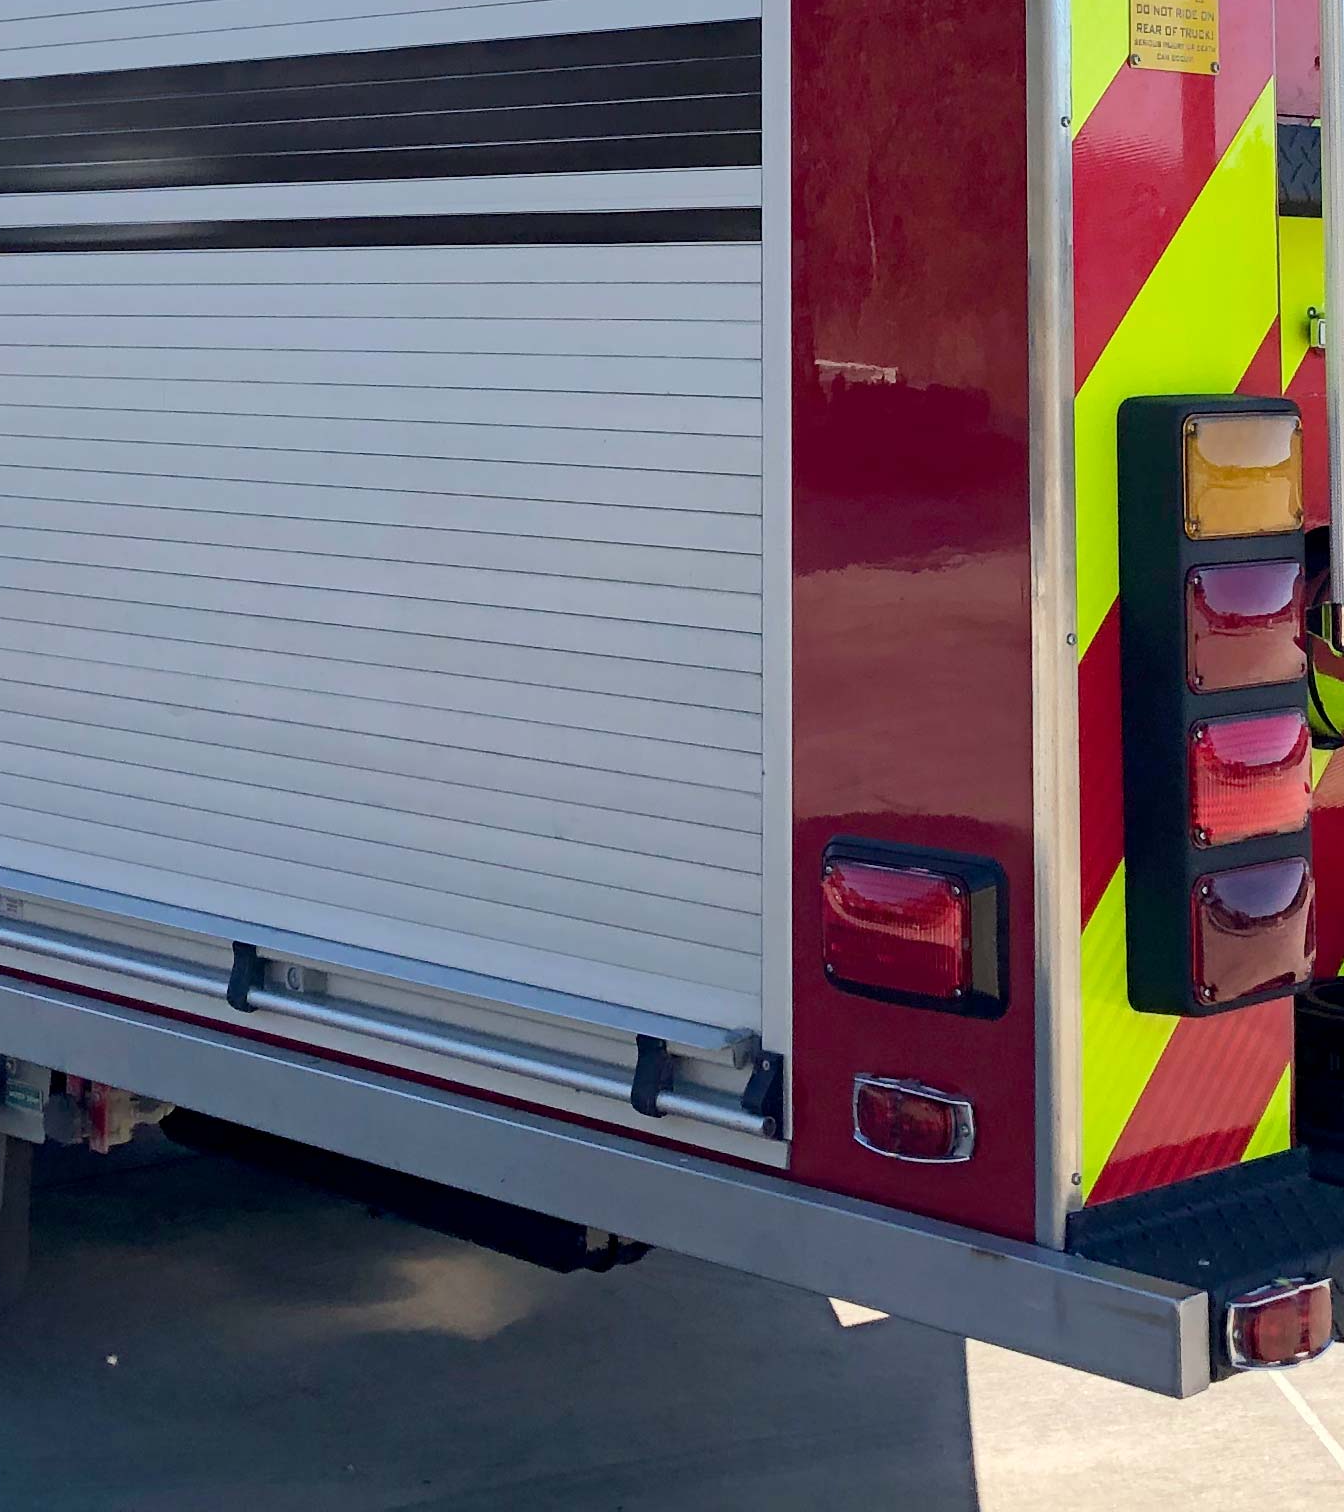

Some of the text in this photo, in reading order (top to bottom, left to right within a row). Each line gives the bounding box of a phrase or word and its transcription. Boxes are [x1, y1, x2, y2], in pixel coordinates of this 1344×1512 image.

[1136, 3, 1215, 22] DO NOT RIDE ON
[1136, 22, 1162, 35] REAR
[1165, 25, 1178, 36] OF
